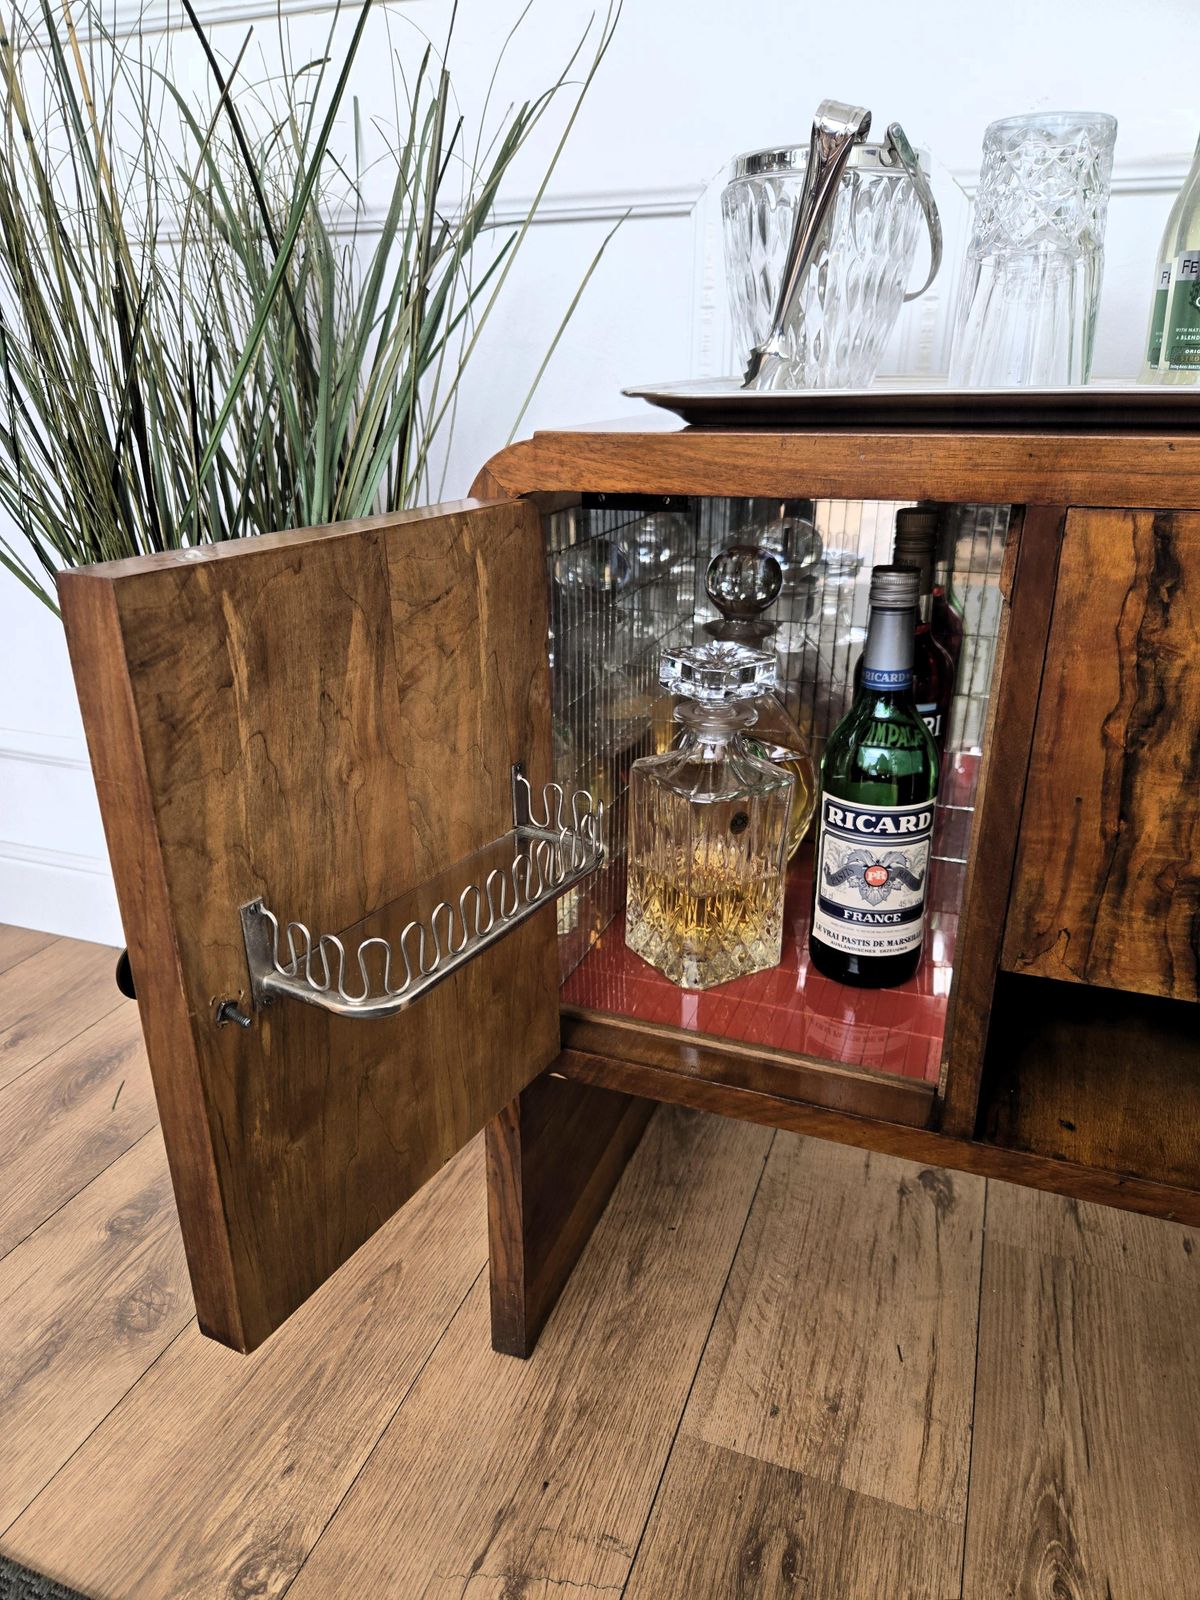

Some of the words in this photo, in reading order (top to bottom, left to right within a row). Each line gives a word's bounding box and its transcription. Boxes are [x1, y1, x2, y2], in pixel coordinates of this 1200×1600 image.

[865, 671, 906, 683] RICARD
[827, 805, 932, 834] RICARD
[843, 909, 902, 924] FRANCE
[822, 926, 840, 941] VRAI
[841, 935, 871, 948] PASTIS
[872, 939, 885, 948] DE
